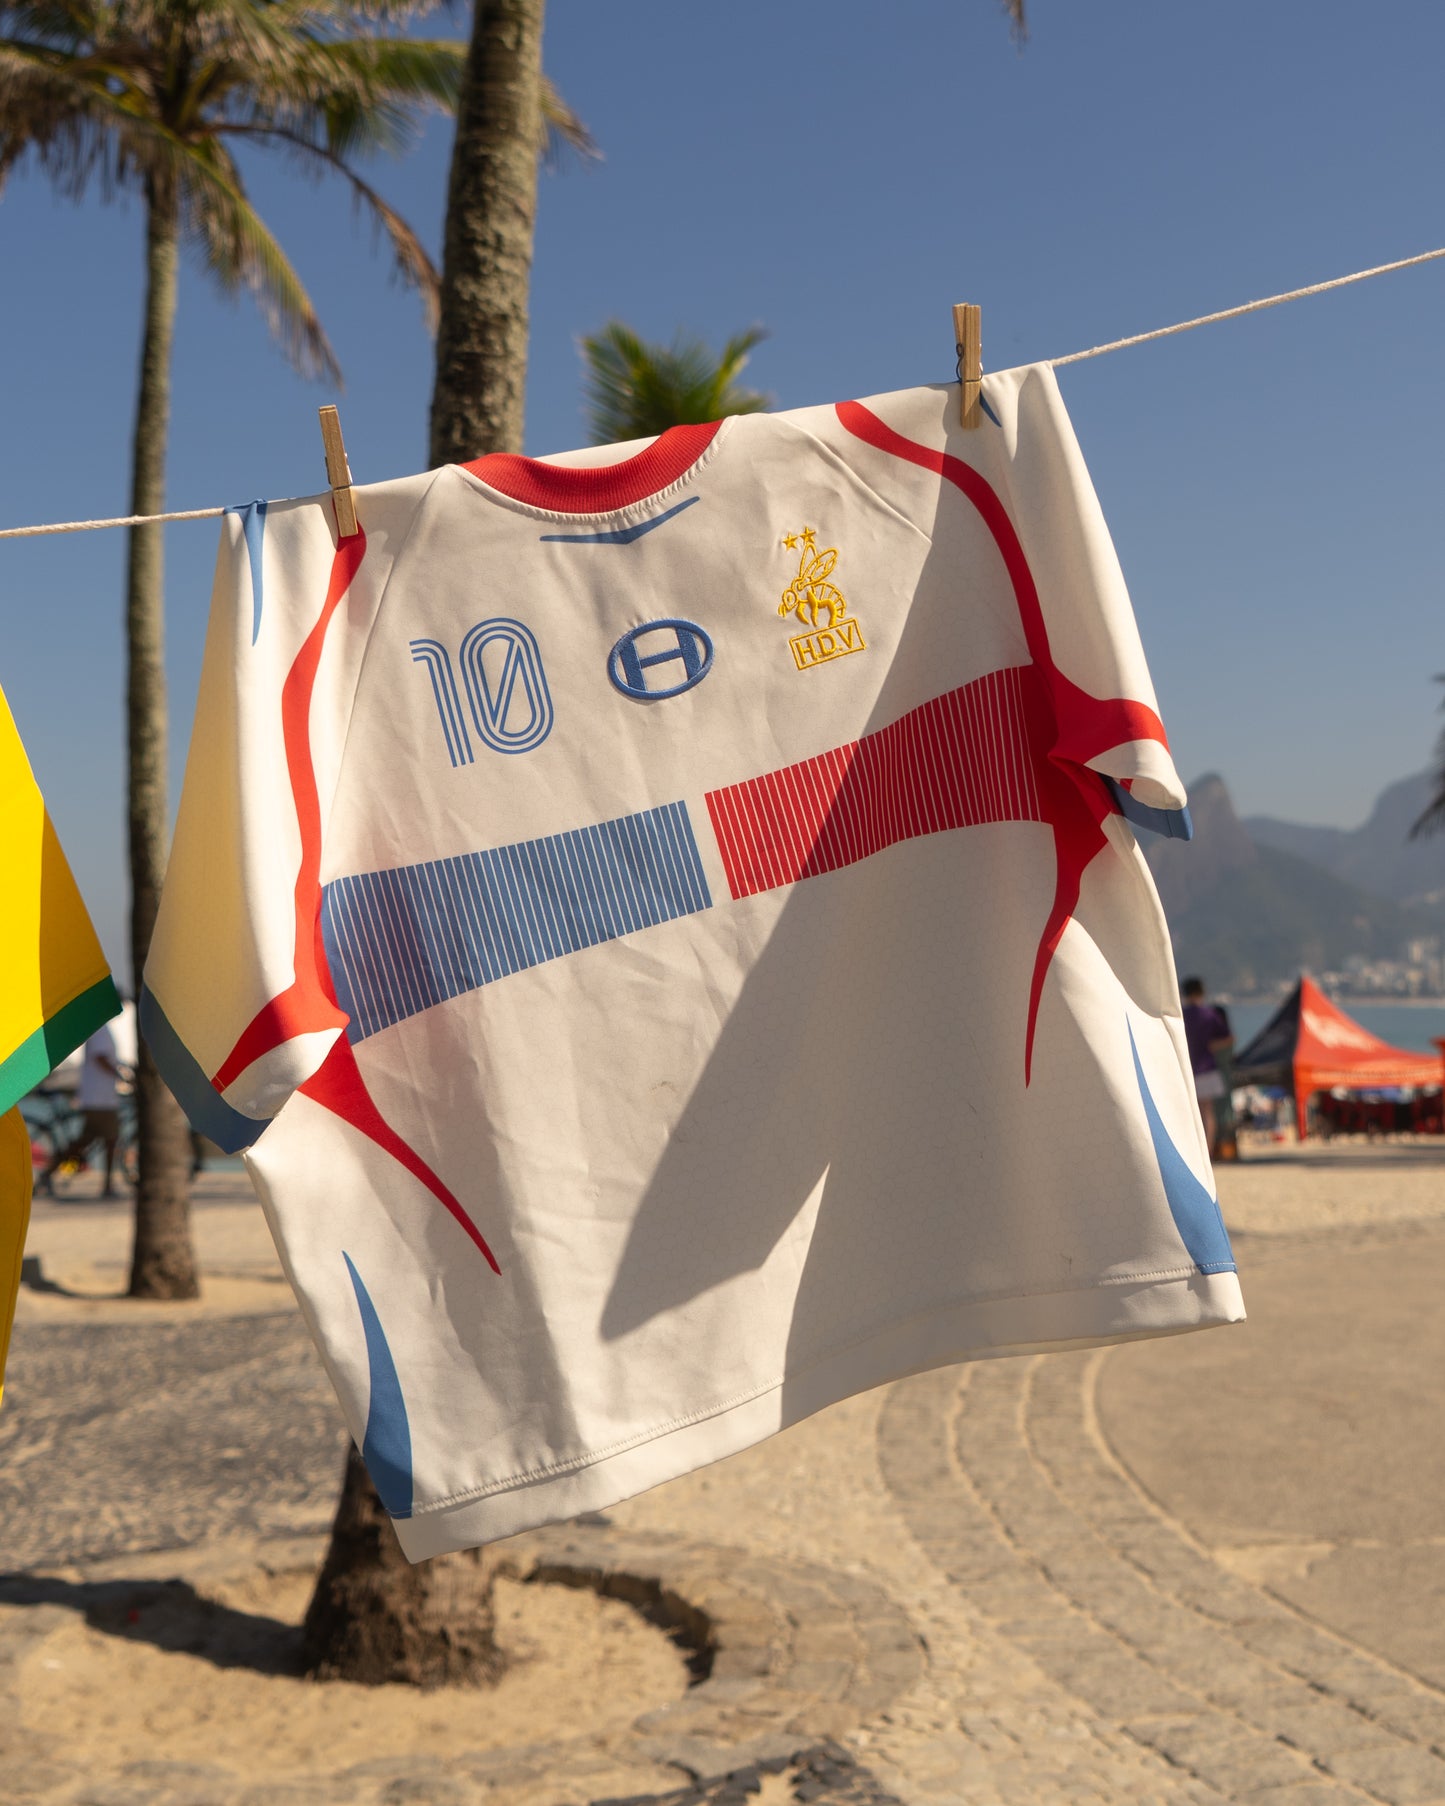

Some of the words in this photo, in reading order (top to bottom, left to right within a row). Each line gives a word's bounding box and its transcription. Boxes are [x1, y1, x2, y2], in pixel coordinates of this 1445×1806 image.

[619, 626, 702, 692] H
[796, 624, 854, 665] H.D.V
[409, 617, 554, 768] 10
